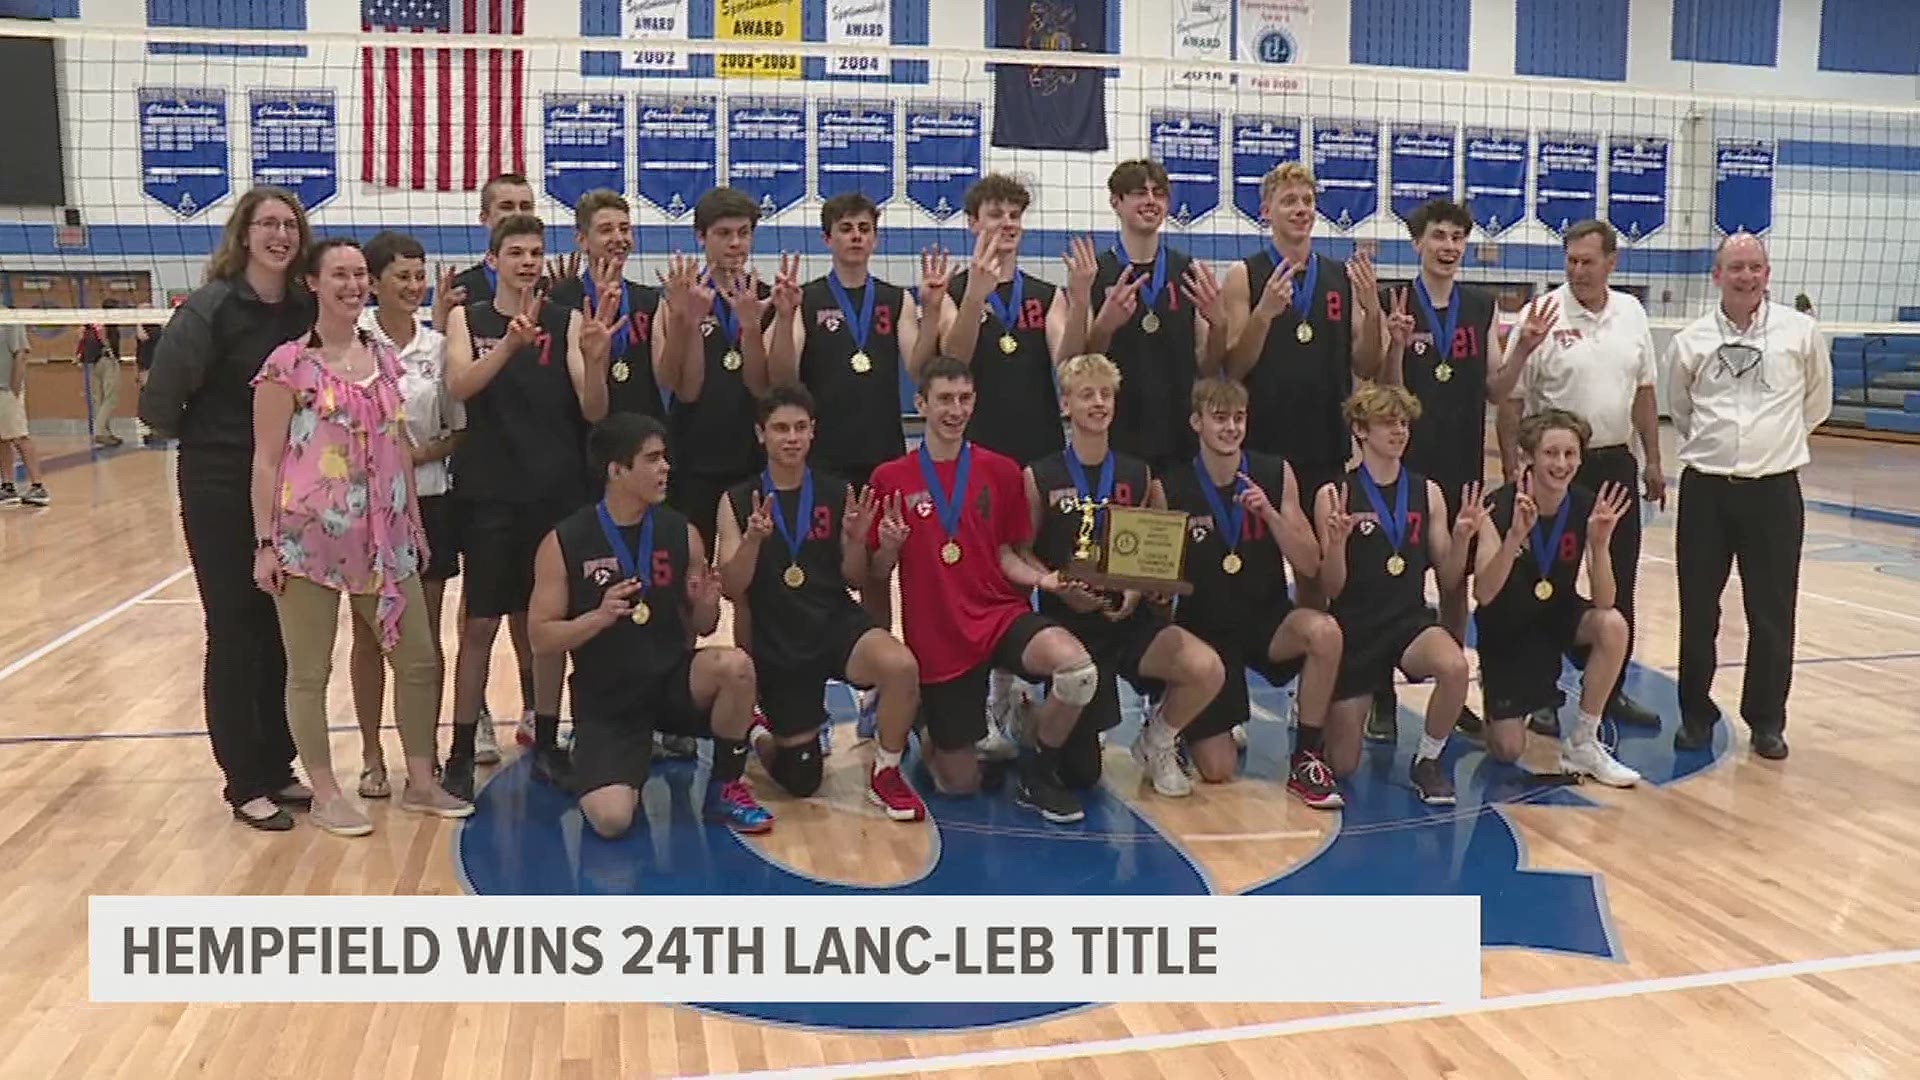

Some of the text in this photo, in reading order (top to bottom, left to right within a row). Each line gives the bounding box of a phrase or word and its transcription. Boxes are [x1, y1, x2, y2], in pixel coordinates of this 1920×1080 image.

[634, 17, 676, 31] AWARD
[733, 20, 784, 37] AWARD
[845, 23, 884, 37] AWARD
[1182, 37, 1221, 48] AWARD
[838, 57, 880, 71] 2004
[1166, 282, 1179, 311] 1
[874, 305, 892, 335] 3
[1407, 512, 1421, 544] 7
